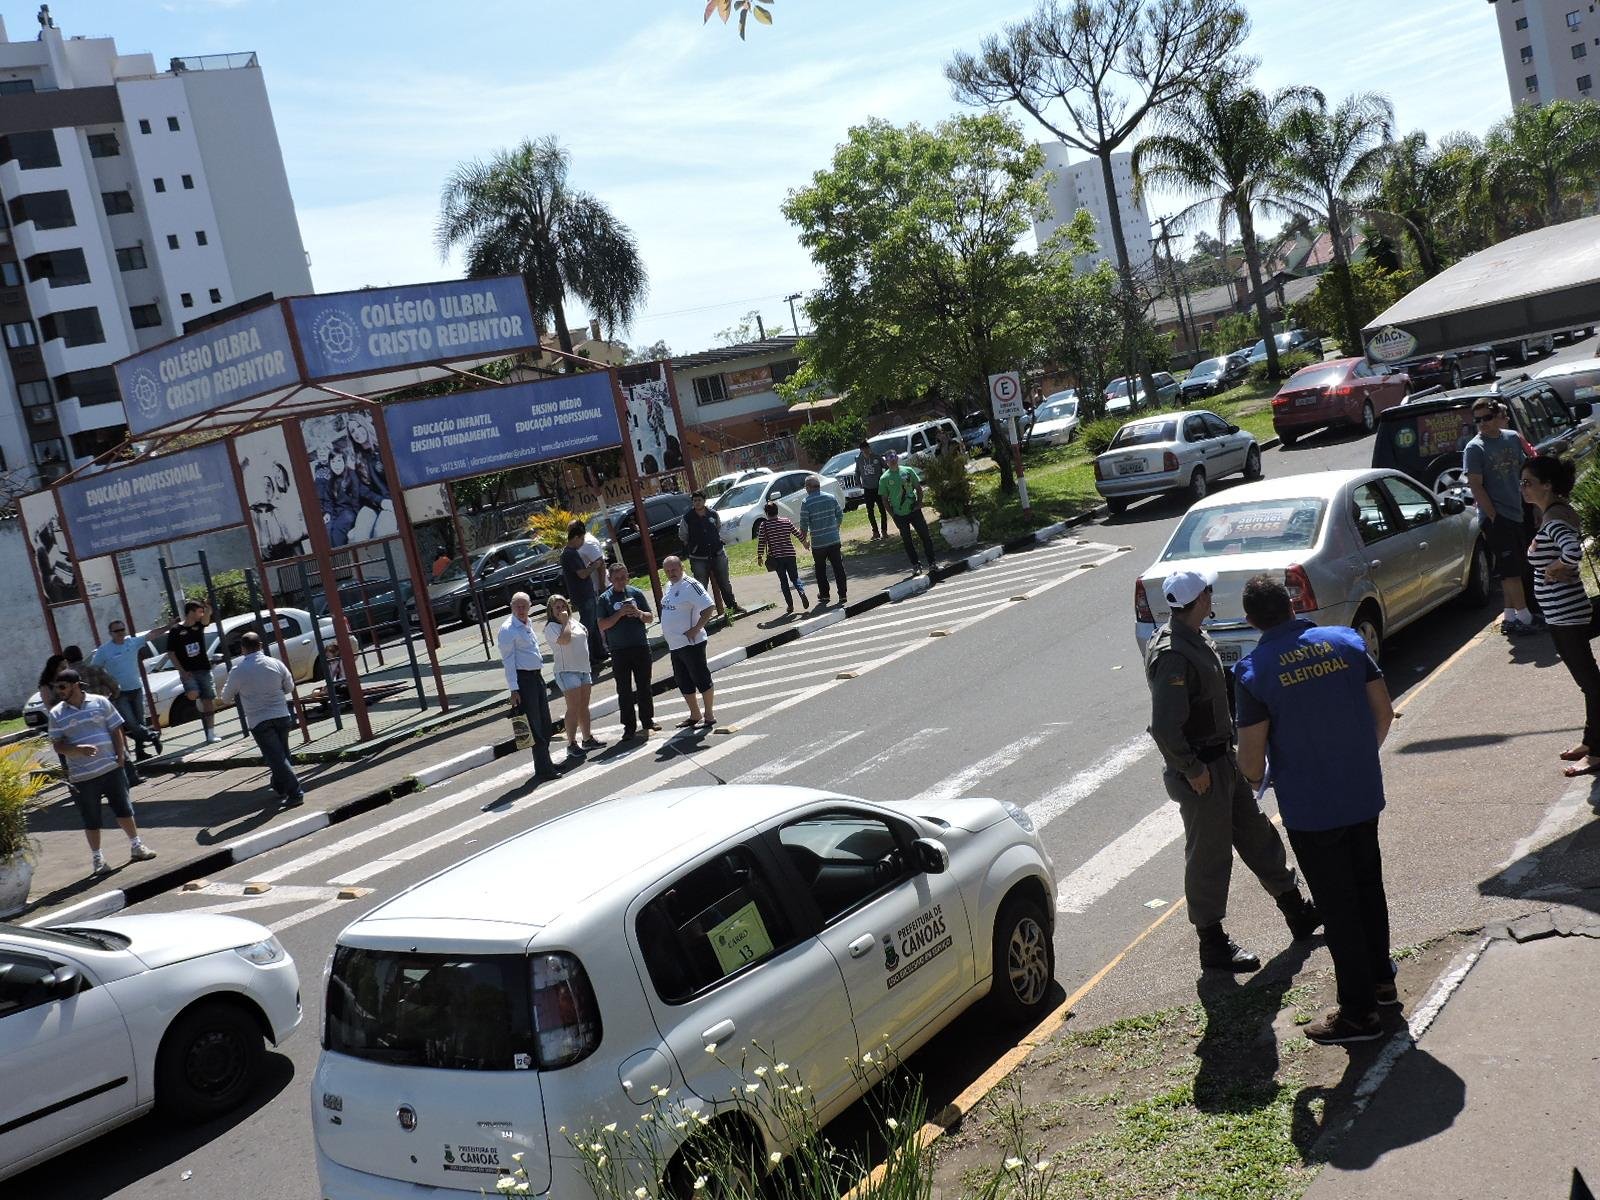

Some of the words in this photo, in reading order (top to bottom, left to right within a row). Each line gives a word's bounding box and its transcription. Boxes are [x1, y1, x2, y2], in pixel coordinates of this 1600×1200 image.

[360, 296, 436, 329] COLÉGIO
[440, 291, 498, 319] ULBRA
[368, 328, 432, 357] CRISTO
[437, 315, 523, 348] REDENTOR
[159, 345, 213, 383] COLÉGIO
[213, 327, 262, 364] ULBRA
[166, 375, 210, 410] CRISTO
[213, 350, 286, 395] REDENTOR
[1001, 381, 1010, 395] E
[532, 401, 558, 416] ENSINO
[559, 397, 582, 411] MÉDIO
[413, 418, 455, 437] EDUCAÇÃO
[456, 414, 492, 430] INFANTIL
[515, 416, 552, 433] EDUCAÇÃO
[553, 408, 602, 426] PROFISSIONAL
[411, 436, 441, 453] ENSINO
[443, 427, 500, 447] FUNDAMENTAL
[86, 478, 131, 507] EDUCAÇÃO
[132, 462, 202, 495] PROFISSIONAL
[1219, 651, 1238, 661] 860
[1279, 641, 1334, 666] JUSTIÇA
[1278, 656, 1349, 687] ELEITORAL
[897, 911, 933, 940] PREFEITURA
[933, 904, 942, 916] DE
[728, 930, 749, 948] CARRO
[902, 915, 946, 957] CANOAS
[739, 944, 754, 960] 13
[460, 1152, 500, 1165] CANOAS
